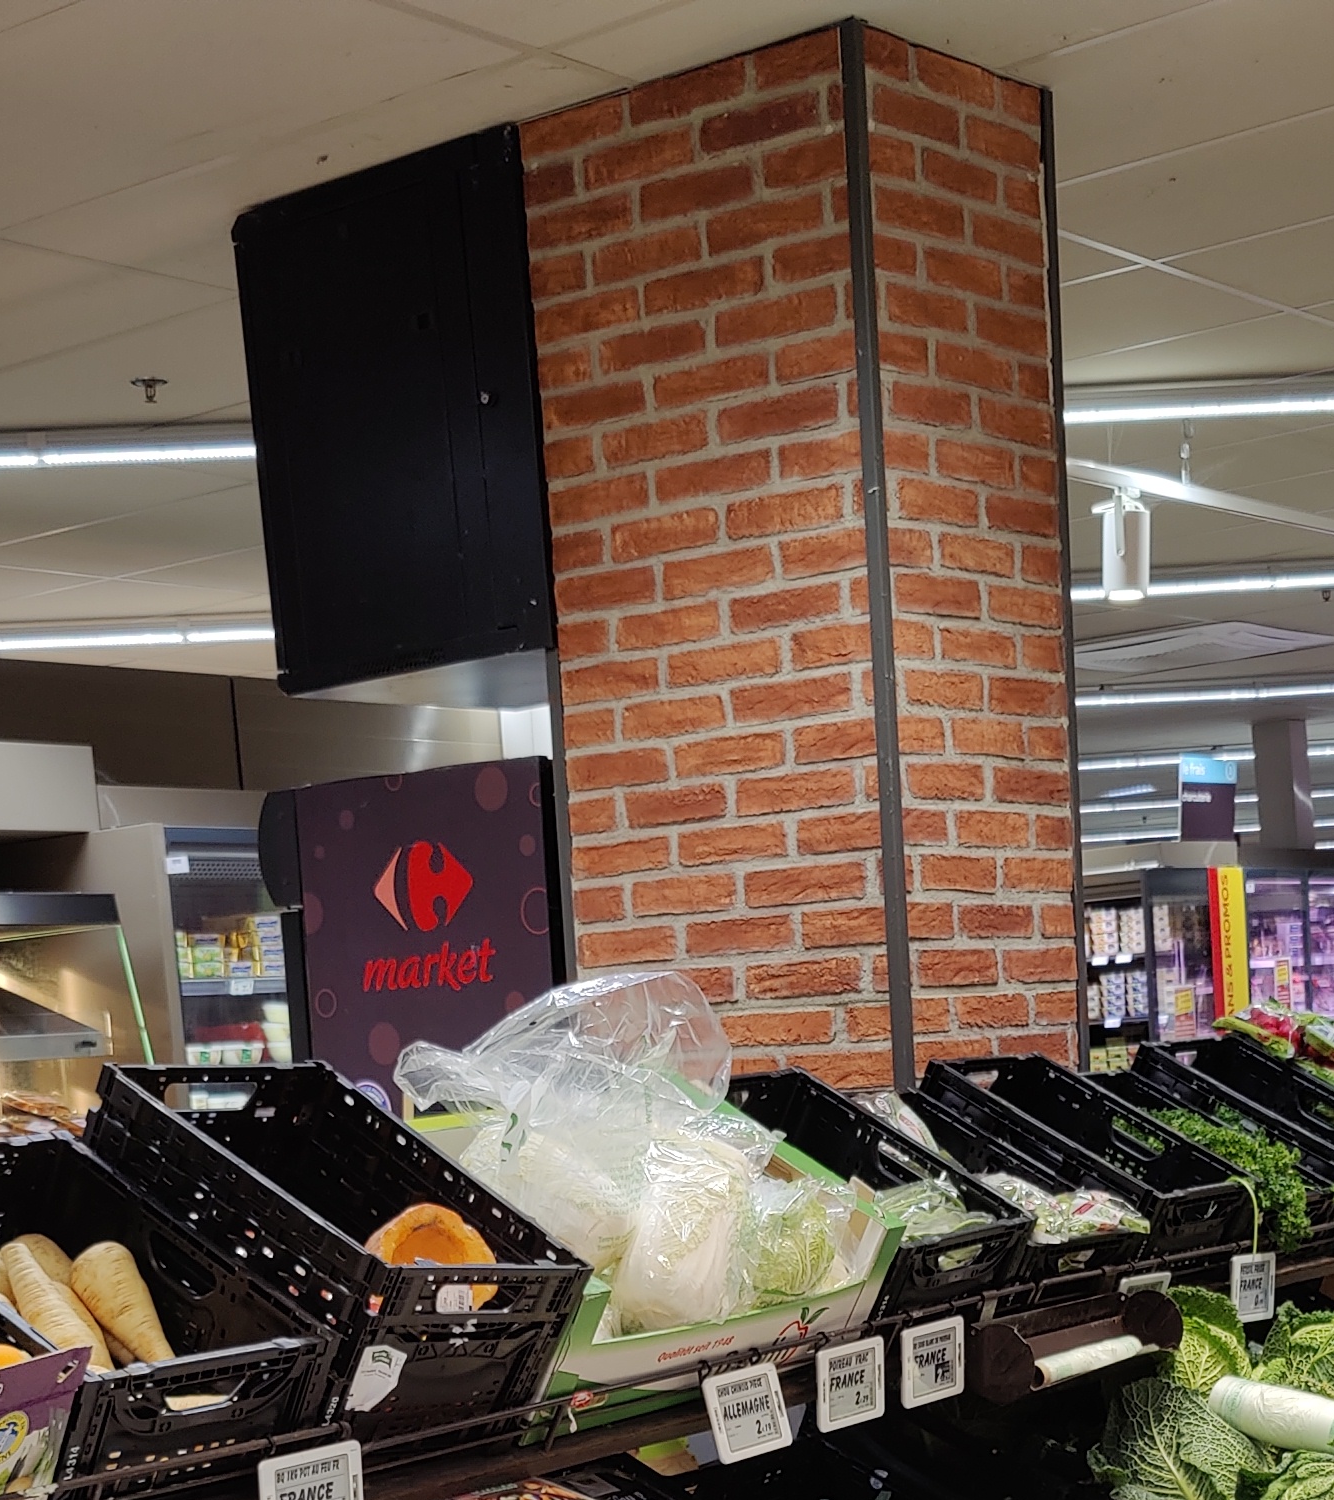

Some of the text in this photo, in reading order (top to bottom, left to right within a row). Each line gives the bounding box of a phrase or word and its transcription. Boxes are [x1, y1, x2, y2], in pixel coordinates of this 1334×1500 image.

[1190, 763, 1206, 777] frais
[1220, 873, 1233, 960] PROMOS
[361, 937, 498, 993] market
[914, 1347, 948, 1369] FRANCE
[829, 1369, 866, 1393] FRANCE
[723, 1394, 771, 1421] ALLEMAGNE
